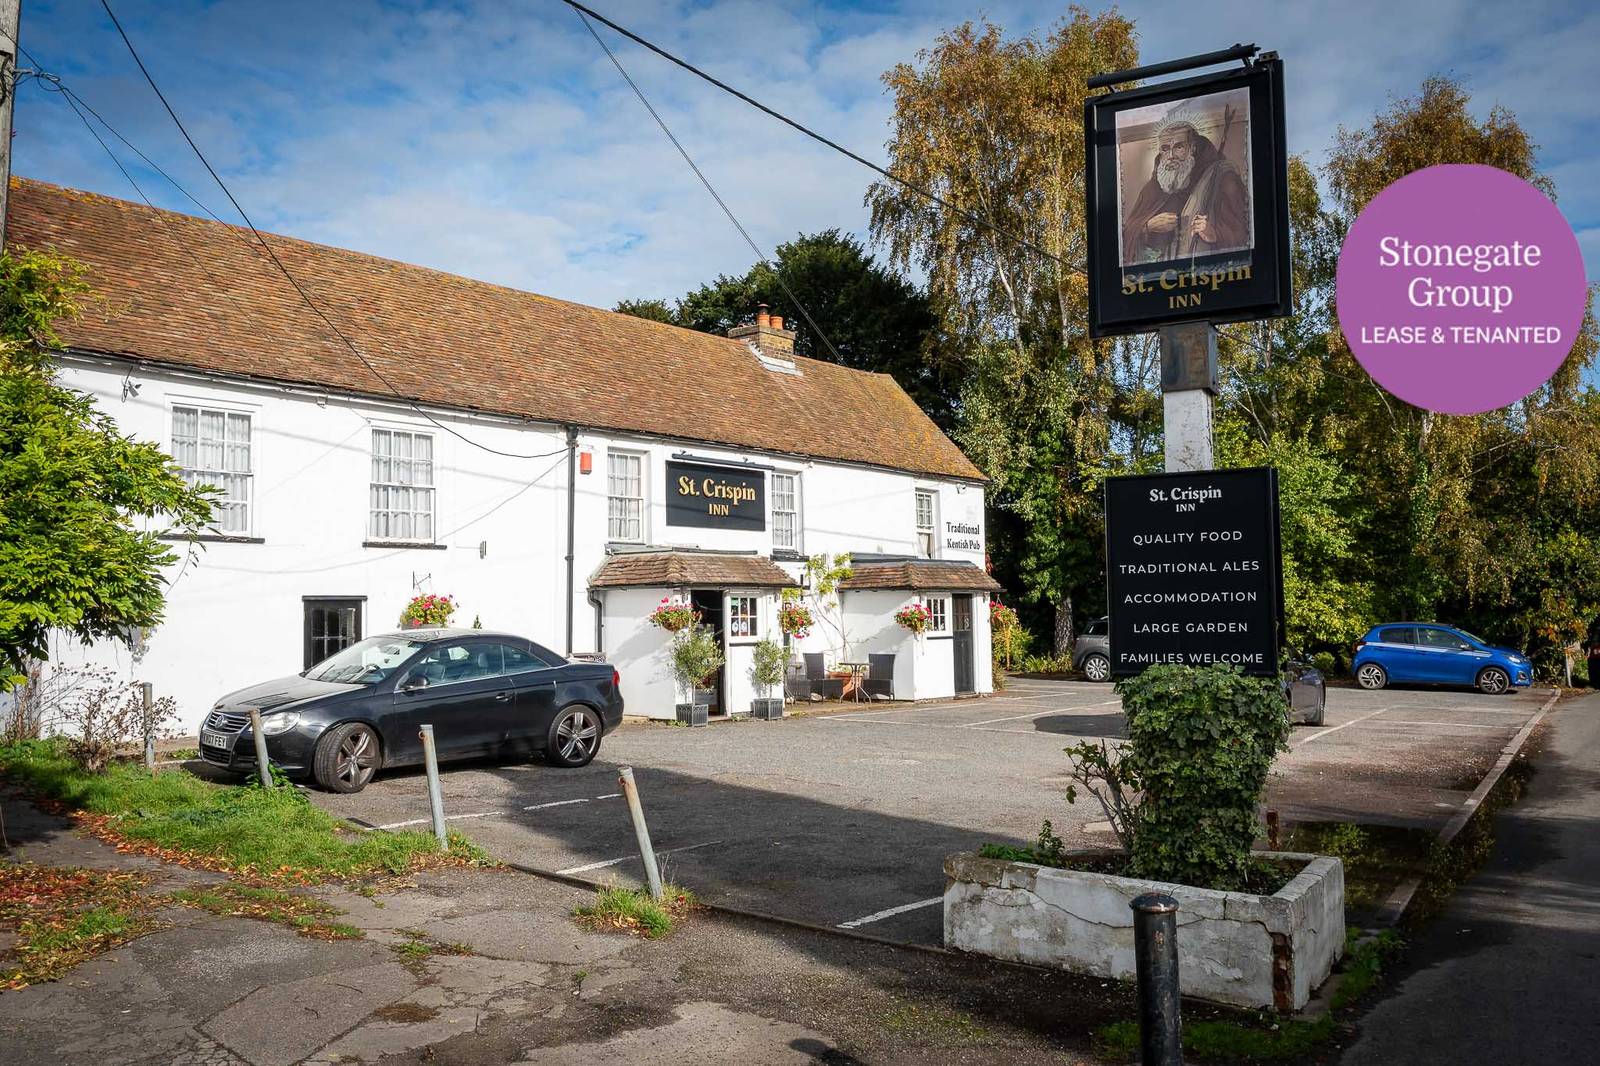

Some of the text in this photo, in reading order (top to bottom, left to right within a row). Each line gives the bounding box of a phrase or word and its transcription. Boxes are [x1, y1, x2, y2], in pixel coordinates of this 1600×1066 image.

[1121, 261, 1253, 295] St. Crispin
[1168, 293, 1201, 309] INN
[678, 475, 756, 506] St. Crispin
[1149, 486, 1222, 502] St. Crispin
[708, 503, 729, 516] INN
[1175, 503, 1196, 512] INN
[946, 521, 980, 535] Traditional
[946, 538, 980, 550] Kentish Pub
[1133, 530, 1243, 546] QUALITY FOOD
[1120, 560, 1260, 574] TRADITIONAL ALES
[1124, 591, 1257, 604] ACCOMMODATION
[1133, 622, 1248, 633] LARGE GARDEN
[1120, 653, 1264, 664] FAMILIES WELCOME
